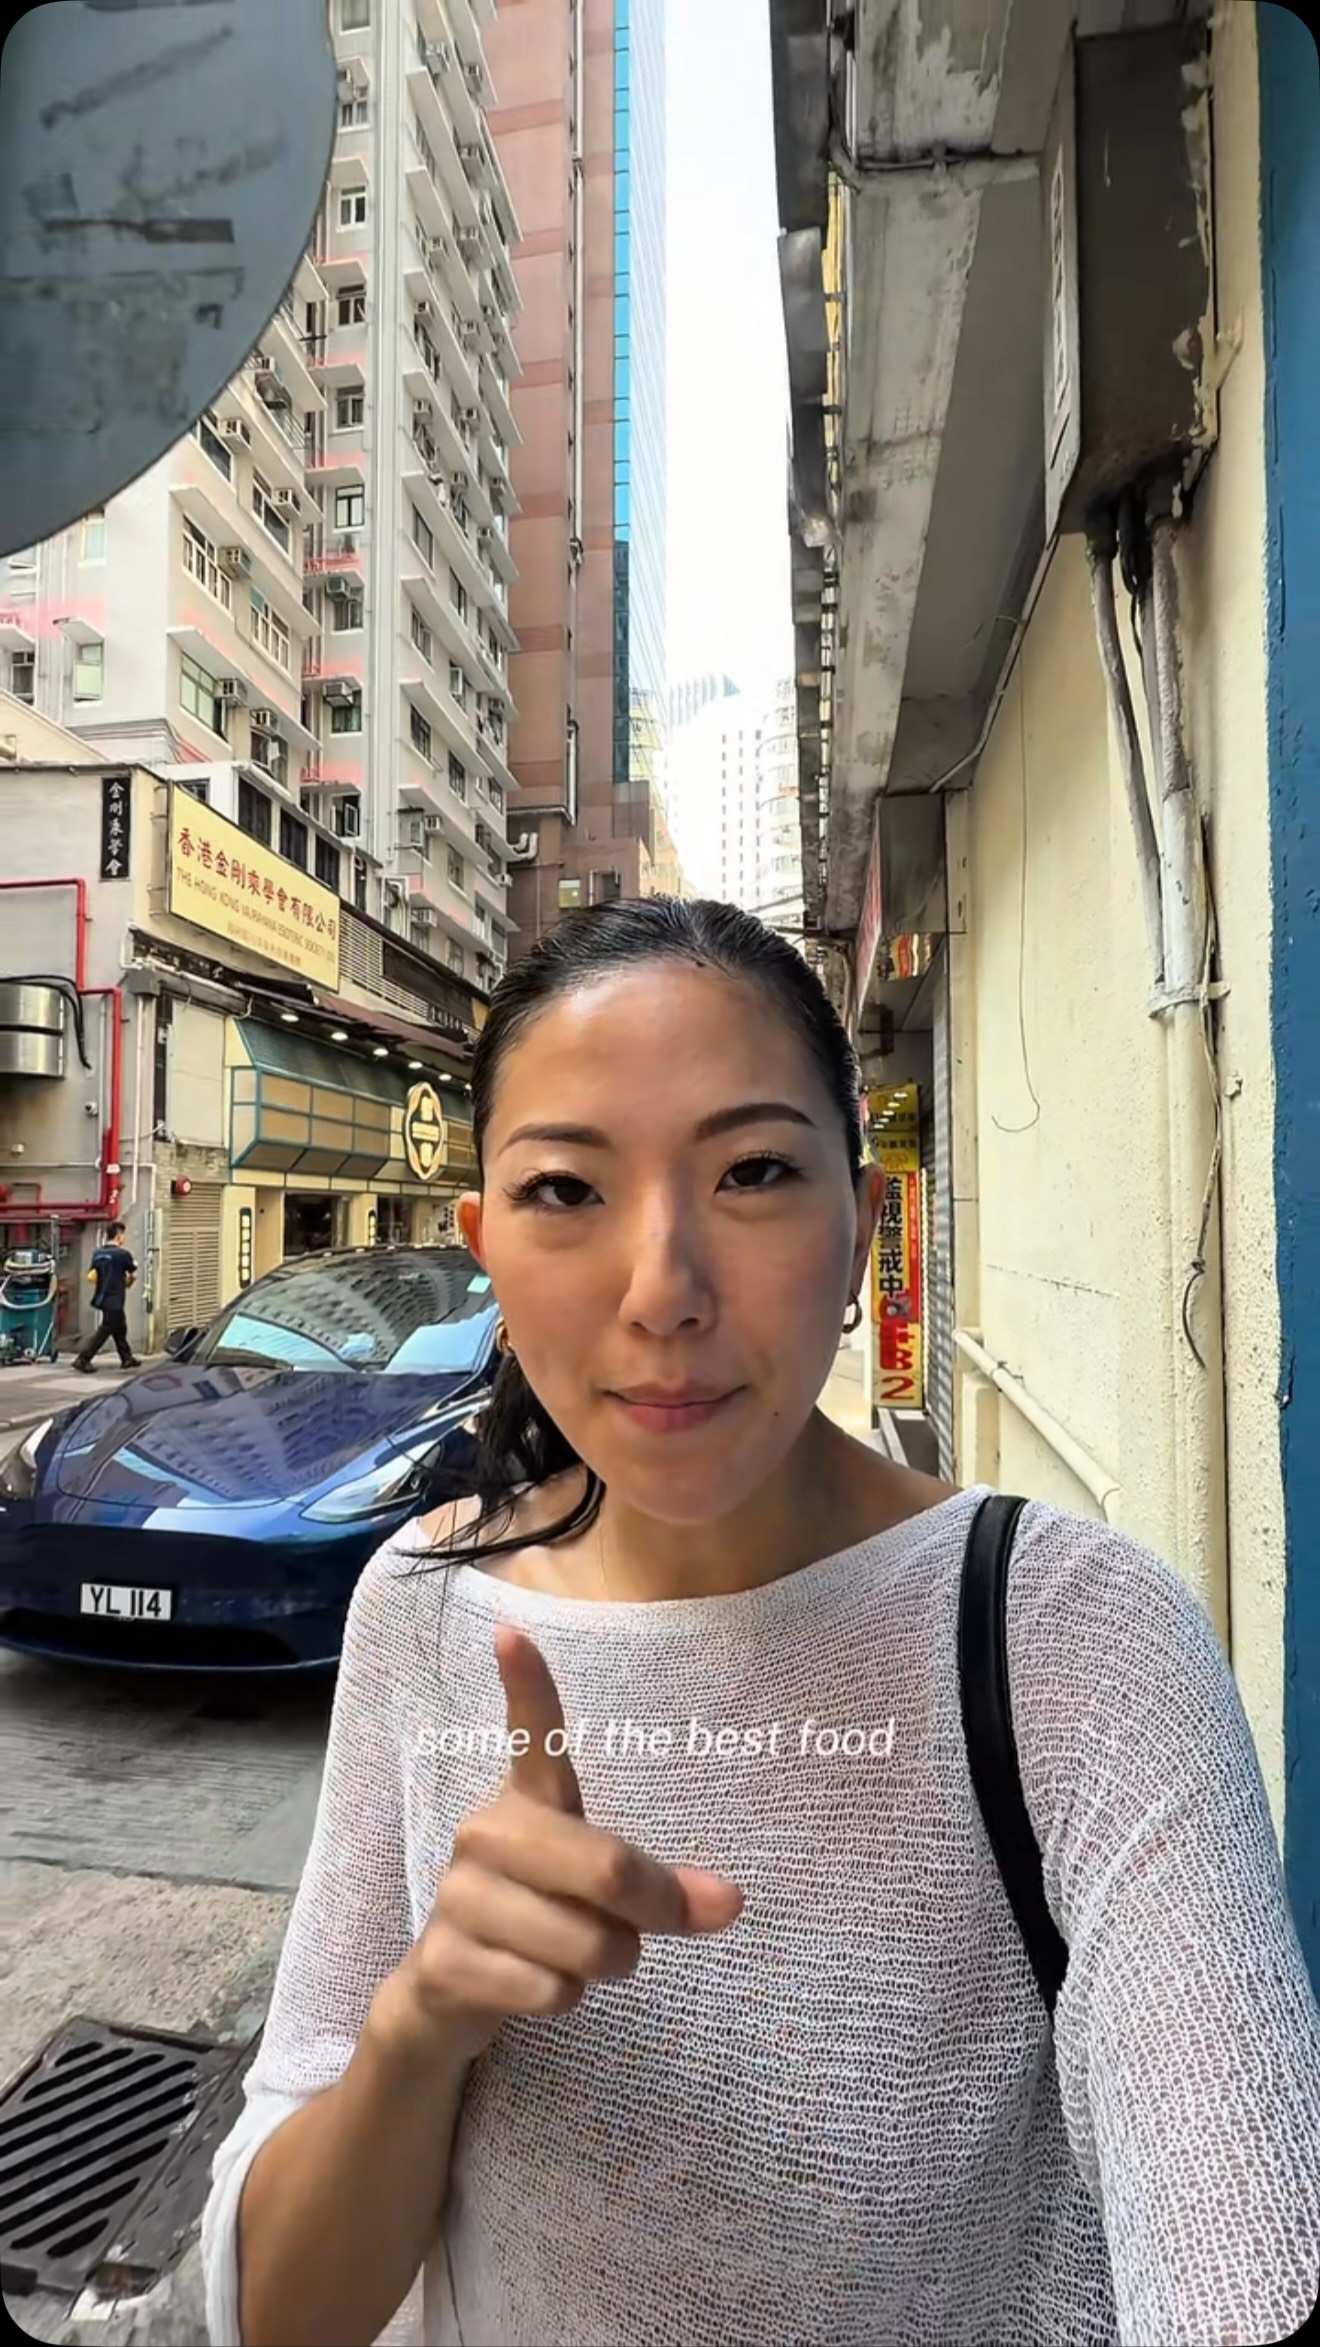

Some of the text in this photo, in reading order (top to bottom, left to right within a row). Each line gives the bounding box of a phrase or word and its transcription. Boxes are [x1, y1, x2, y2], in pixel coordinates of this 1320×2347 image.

[176, 866, 192, 888] THE
[194, 876, 217, 901] HONG
[219, 891, 240, 913] KONG
[90, 1586, 162, 1617] YL 114
